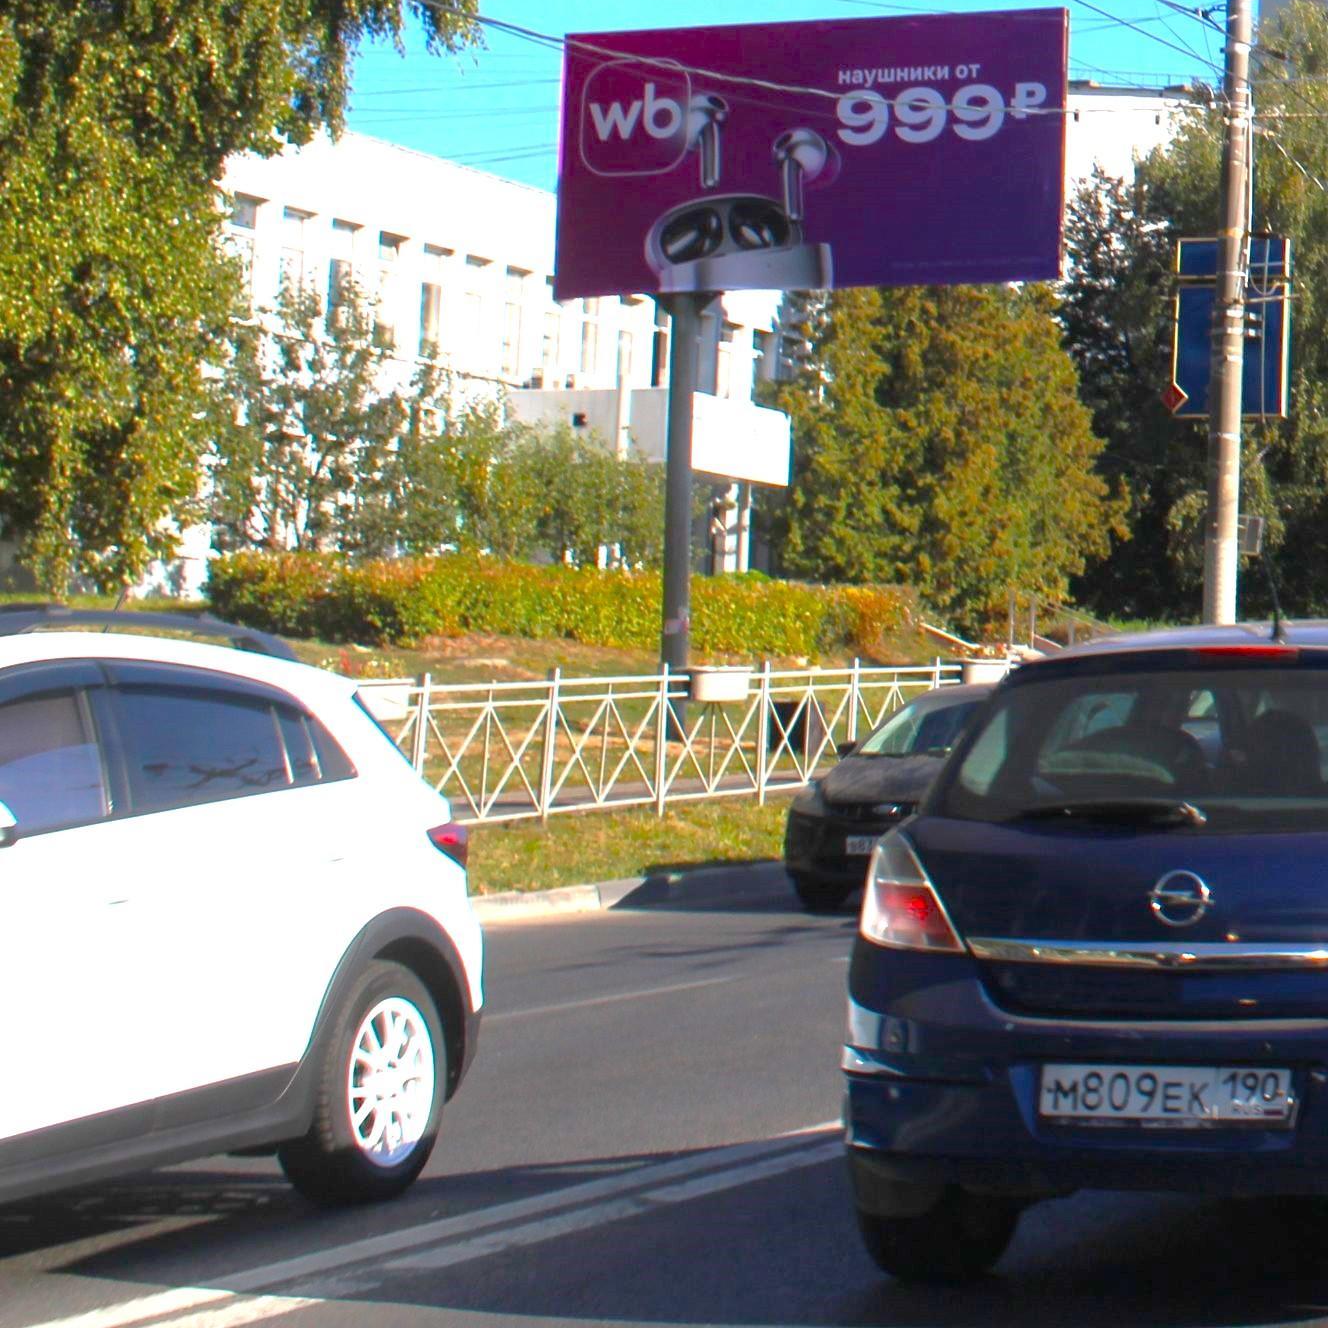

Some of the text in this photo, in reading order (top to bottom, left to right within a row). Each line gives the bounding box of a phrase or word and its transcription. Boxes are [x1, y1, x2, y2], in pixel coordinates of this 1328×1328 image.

[837, 63, 981, 88] наушники от
[588, 81, 683, 142] wb
